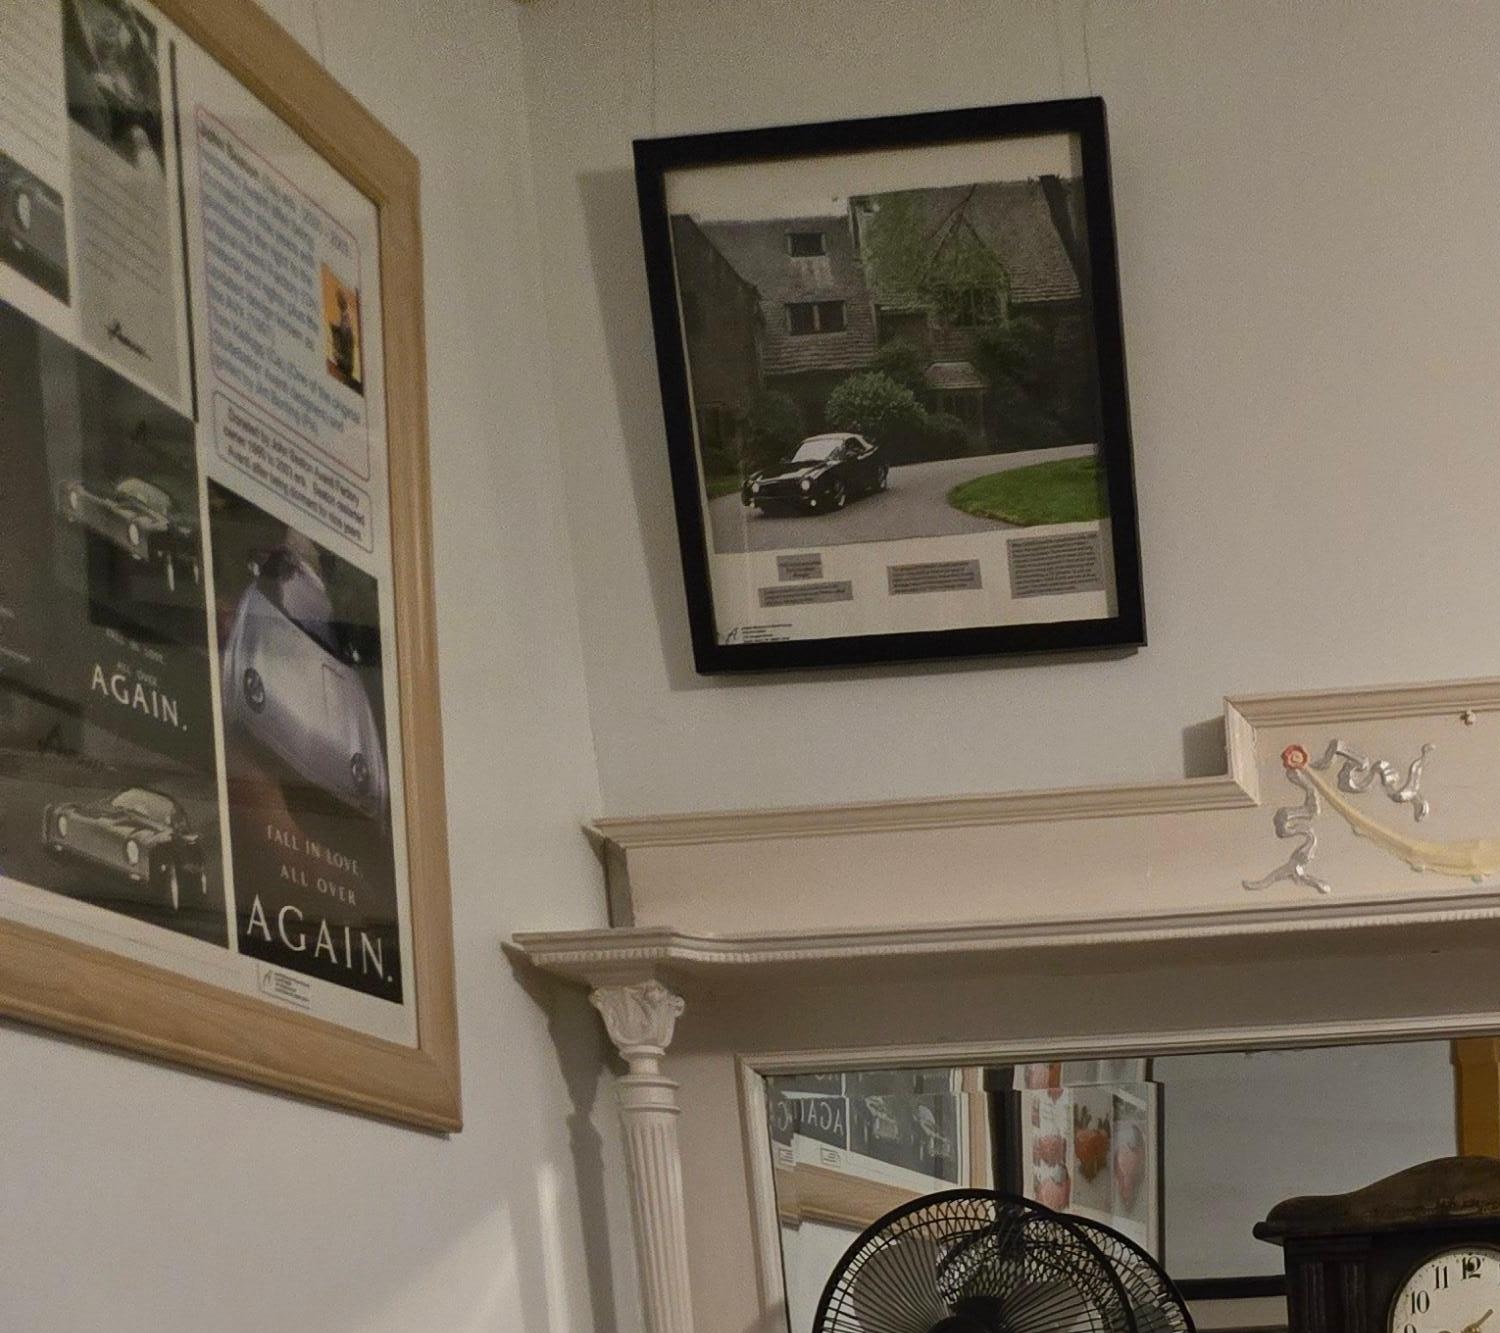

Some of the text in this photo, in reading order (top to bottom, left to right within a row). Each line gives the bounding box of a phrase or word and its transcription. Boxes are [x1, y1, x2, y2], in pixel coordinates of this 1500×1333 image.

[91, 664, 188, 731] AGAIN.
[280, 864, 356, 905] ALL OVER
[247, 894, 392, 982] AGAIN.
[1435, 1266, 1448, 1289] 11
[1410, 1290, 1430, 1314] 10
